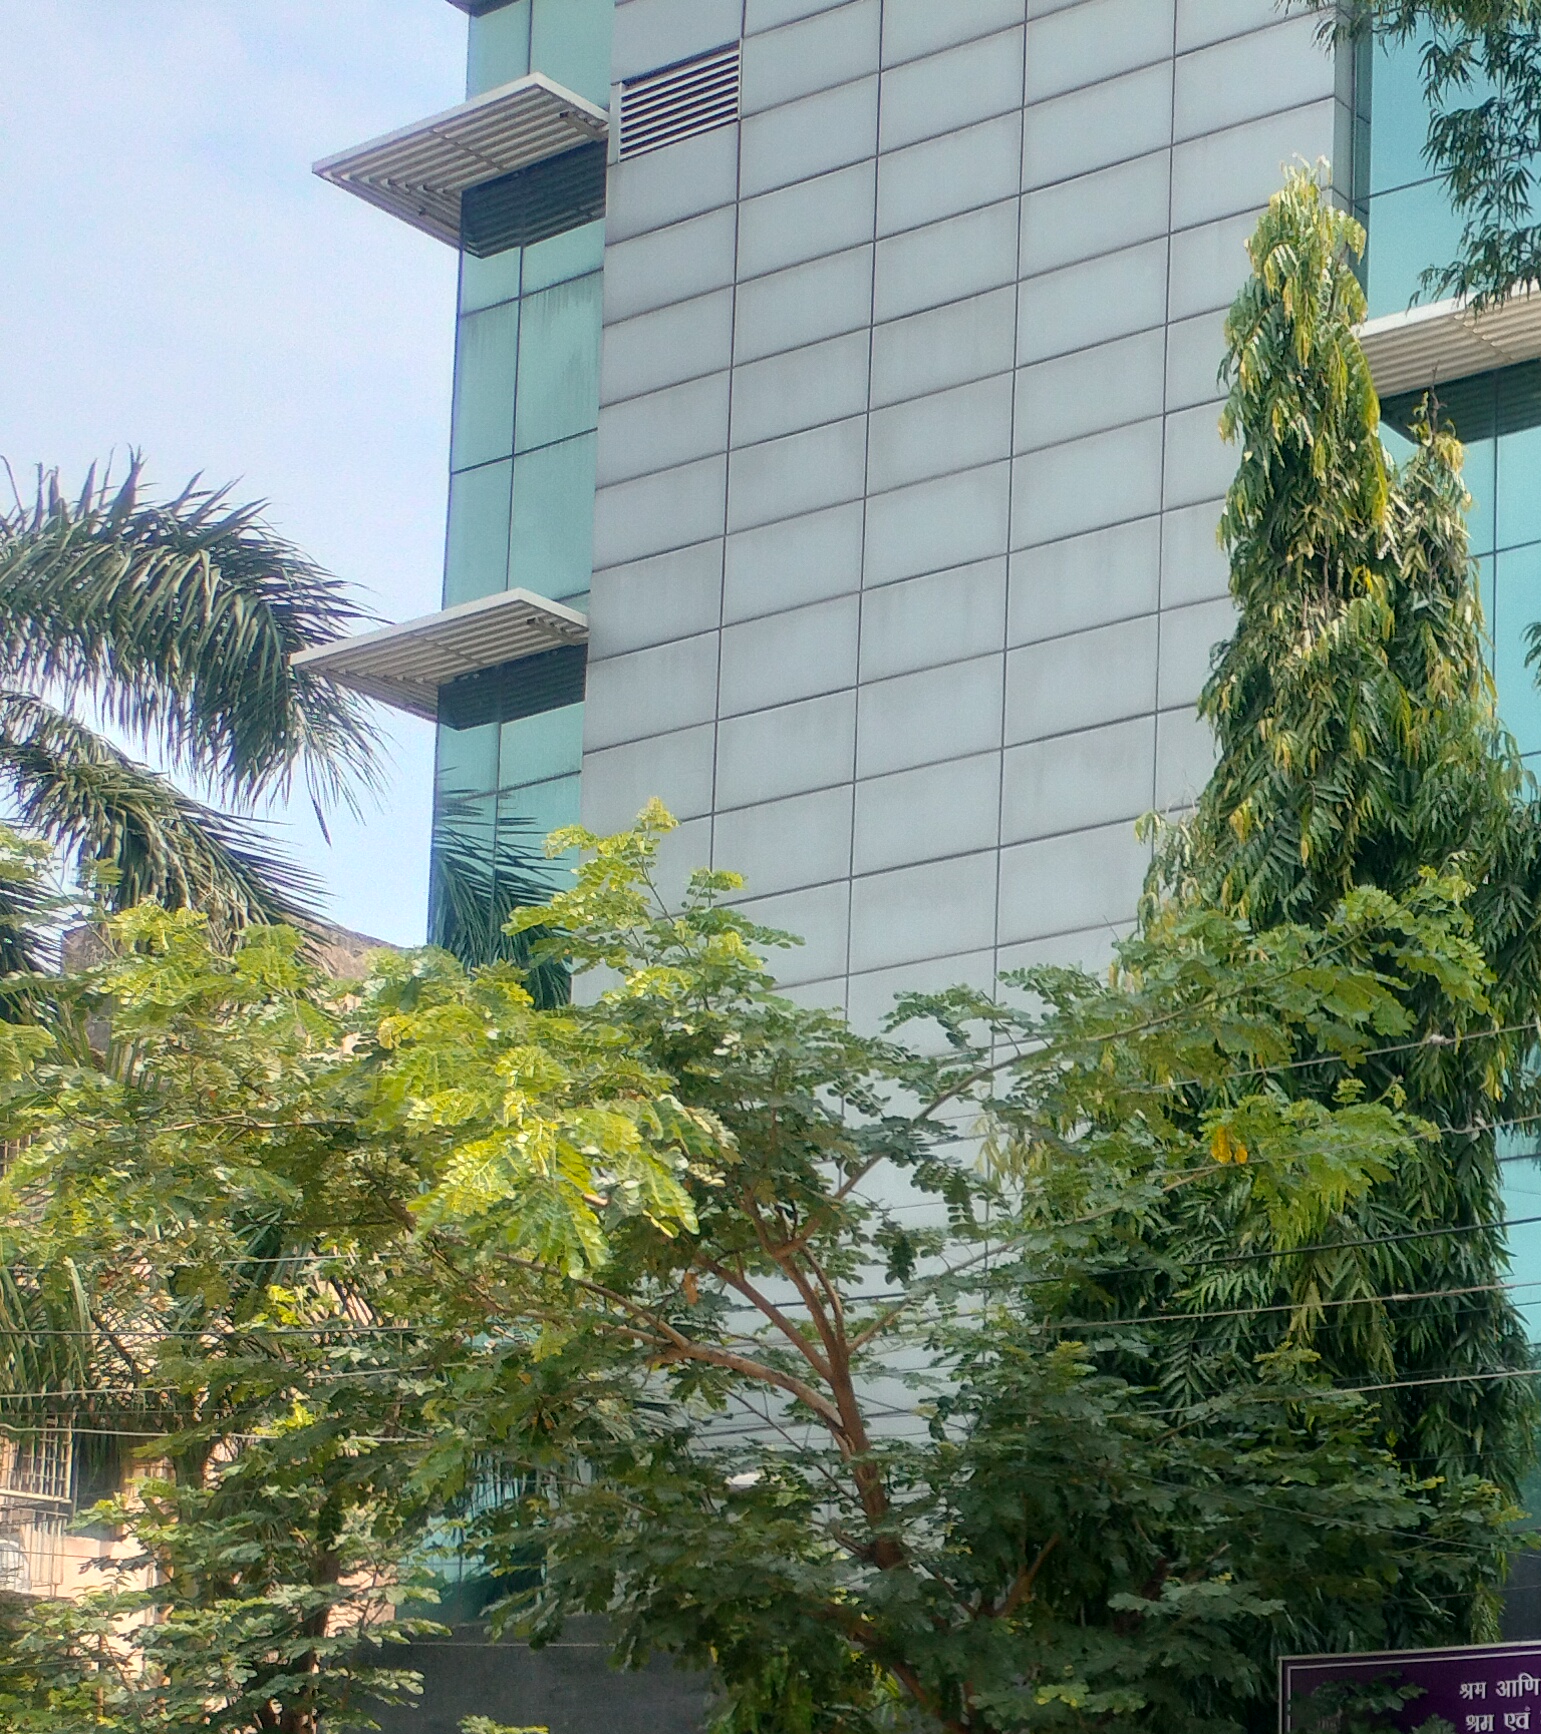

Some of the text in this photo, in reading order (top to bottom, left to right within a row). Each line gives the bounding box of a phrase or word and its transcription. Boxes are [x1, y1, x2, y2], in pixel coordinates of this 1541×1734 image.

[1460, 1681, 1487, 1700] श्रम
[1495, 1672, 1540, 1698] आणि
[1465, 1713, 1494, 1733] श्रम
[1504, 1705, 1530, 1731] एवं
